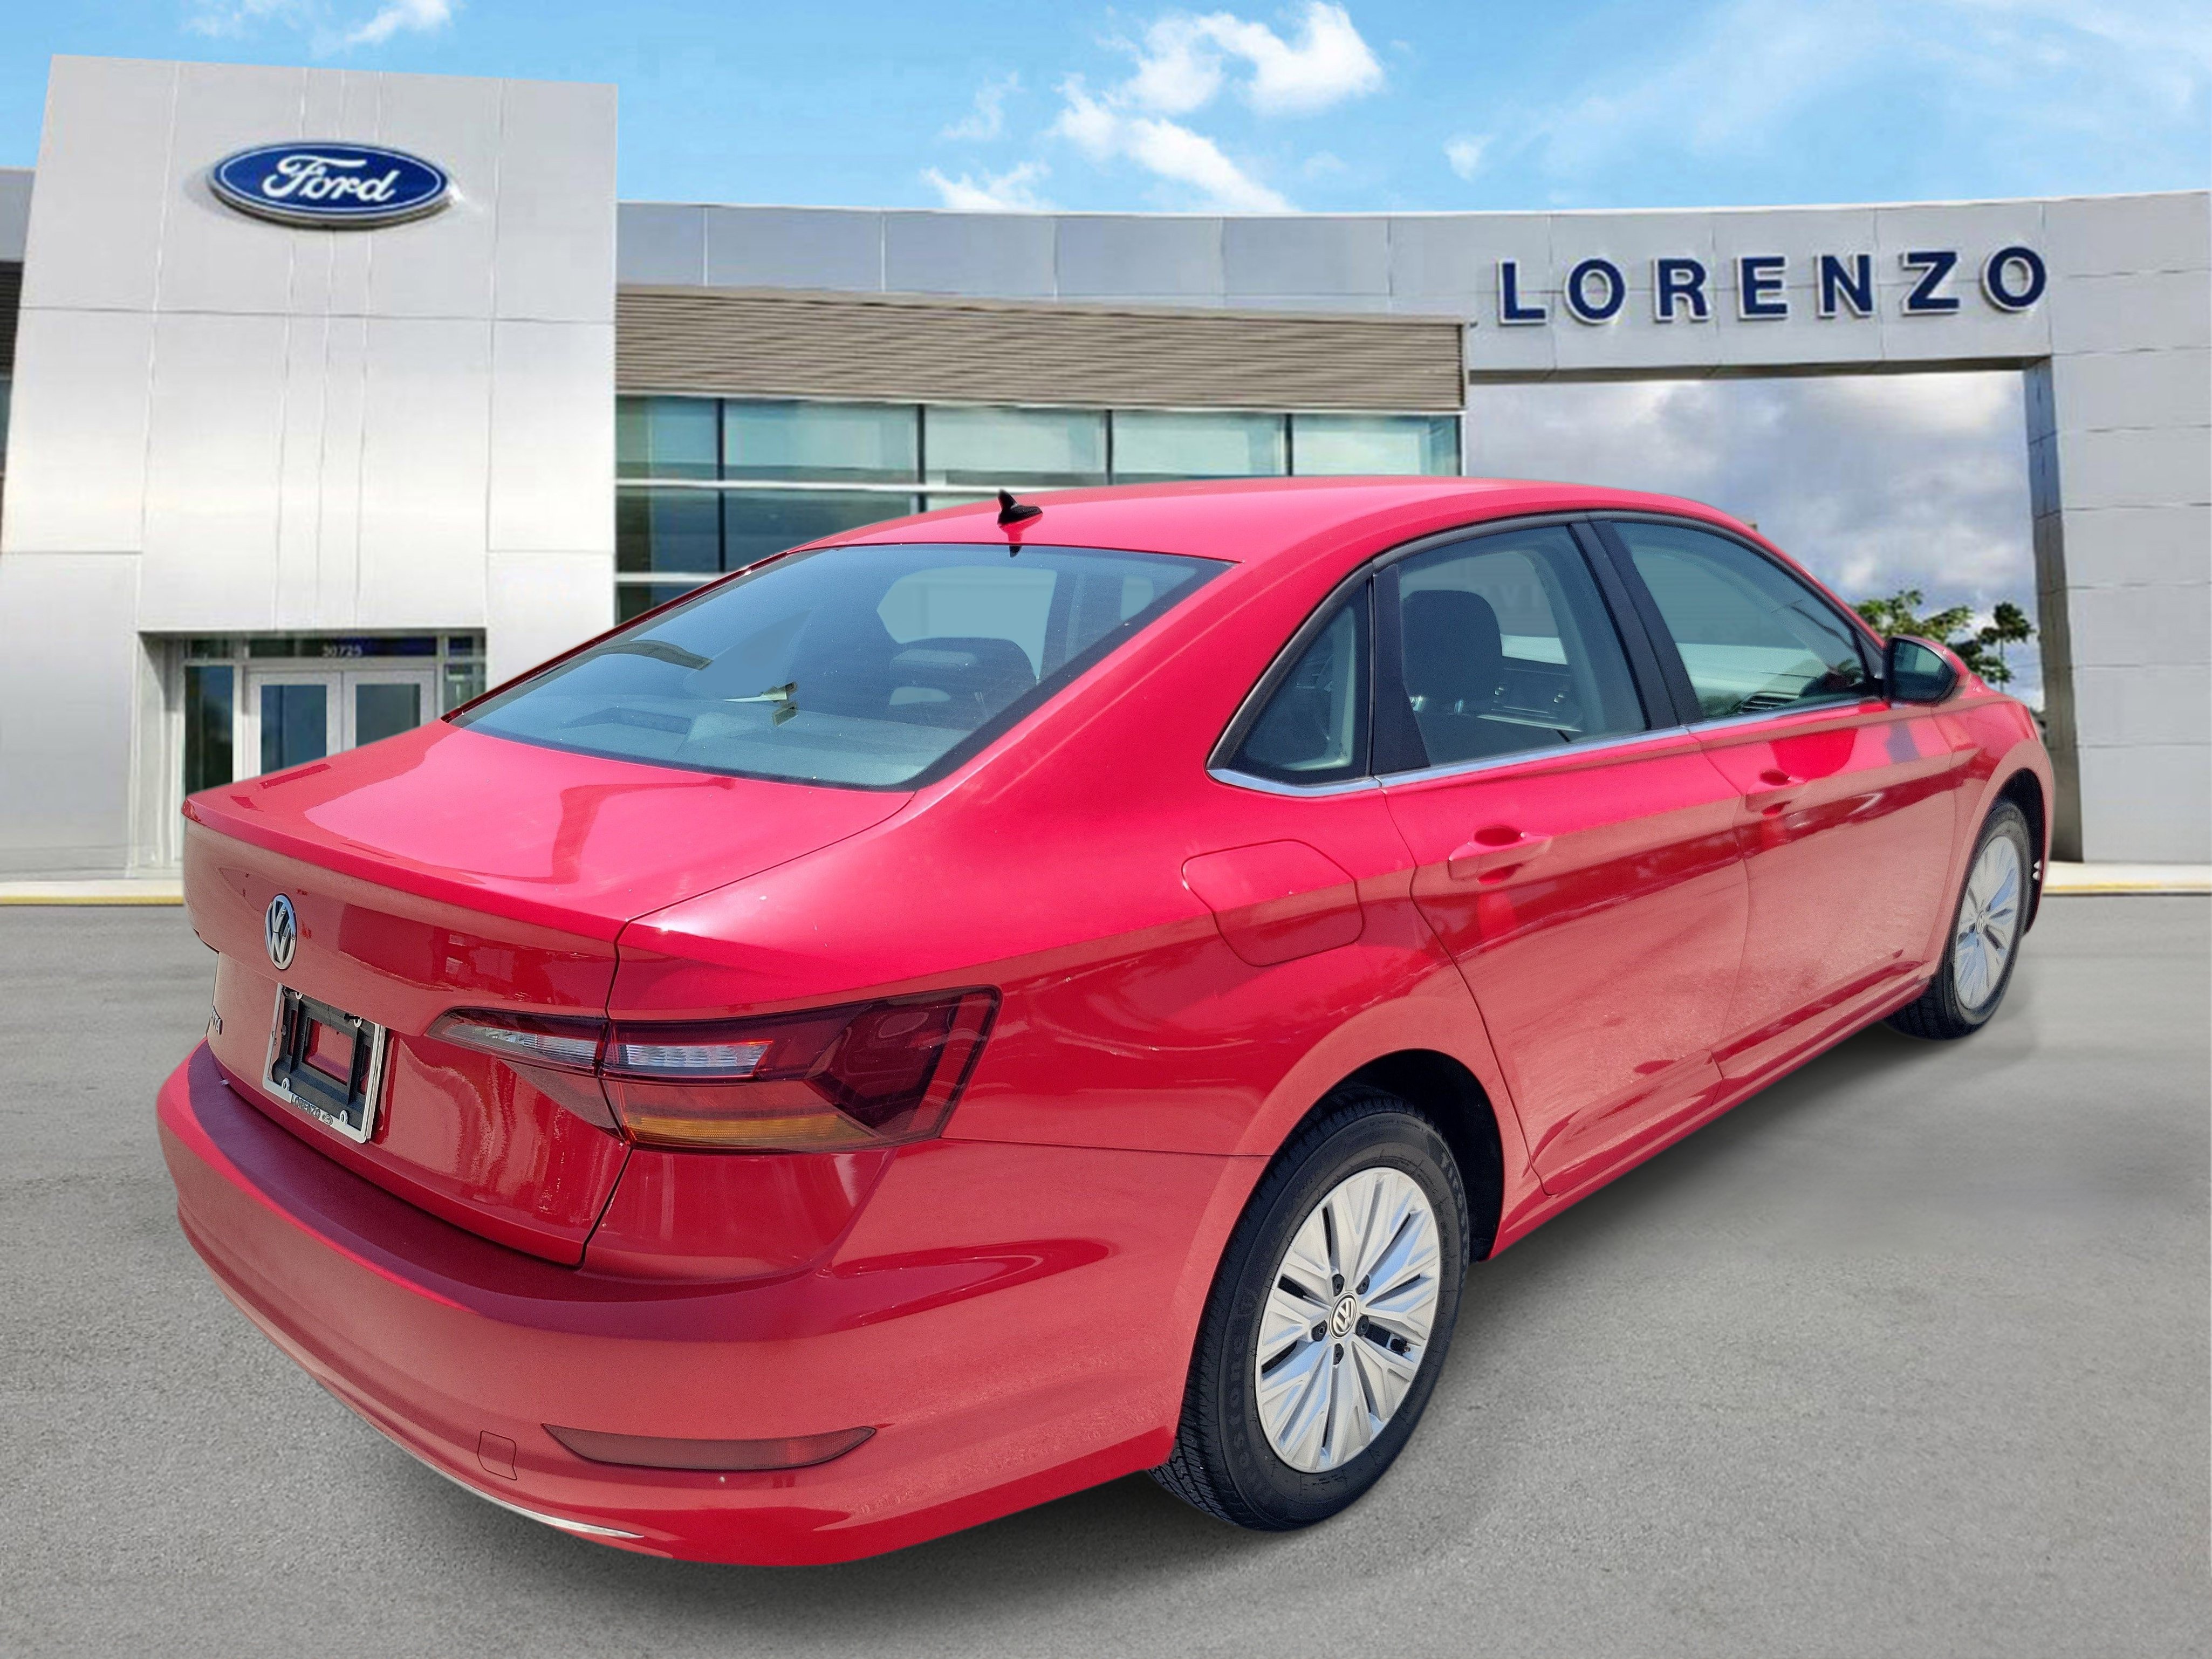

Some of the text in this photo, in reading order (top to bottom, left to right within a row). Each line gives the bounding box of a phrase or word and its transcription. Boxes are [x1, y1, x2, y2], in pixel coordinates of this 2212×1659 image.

[263, 155, 400, 202] Ford
[1497, 245, 2046, 325] LORENZO
[291, 1093, 321, 1120] LORENZO
